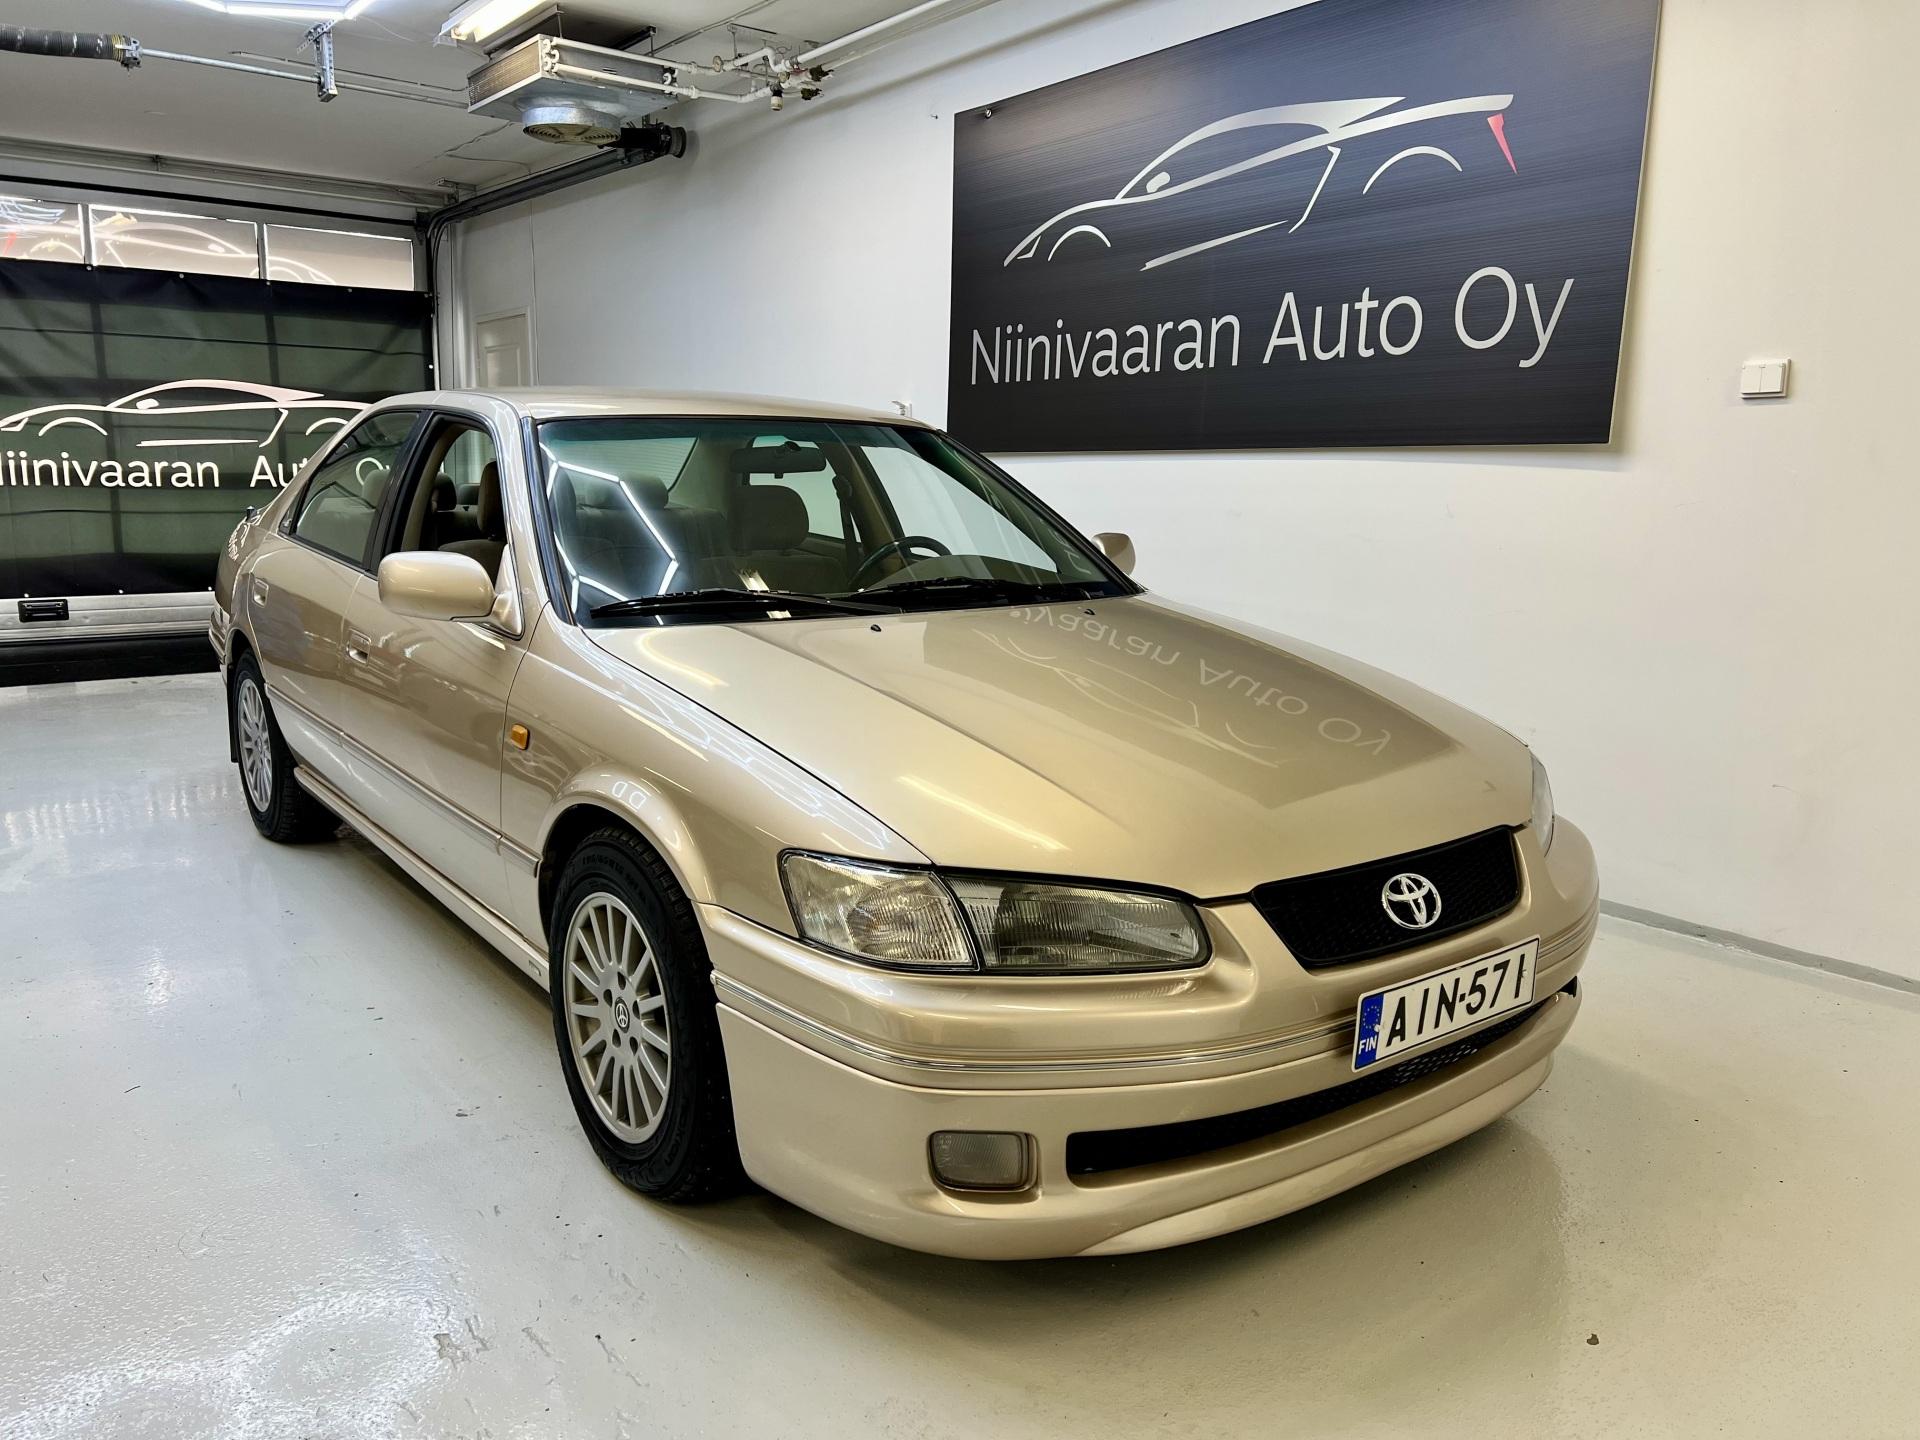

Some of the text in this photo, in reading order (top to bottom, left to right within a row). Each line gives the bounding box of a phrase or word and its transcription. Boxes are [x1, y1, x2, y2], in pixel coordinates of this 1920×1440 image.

[970, 266, 1575, 386] Niinivaaran Auto Oy
[1358, 1036, 1378, 1055] FIN
[1386, 953, 1525, 1048] AIN-571
